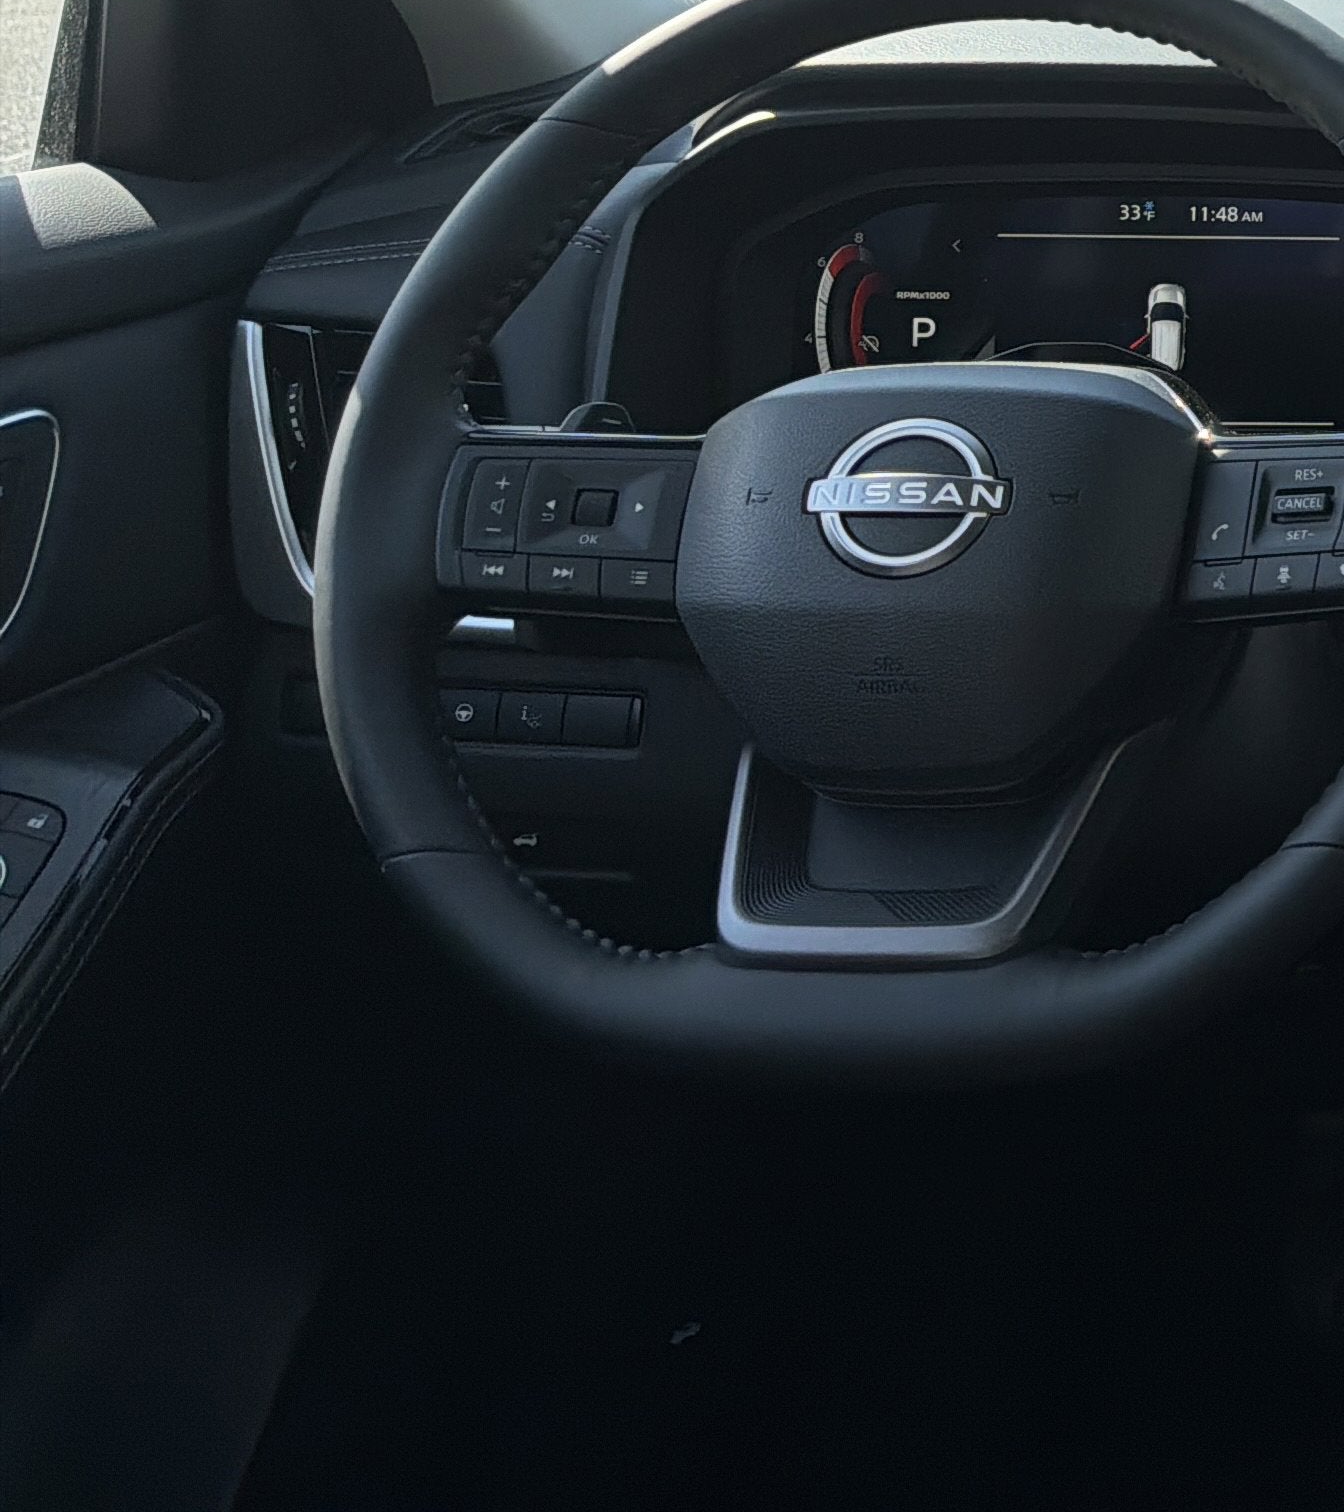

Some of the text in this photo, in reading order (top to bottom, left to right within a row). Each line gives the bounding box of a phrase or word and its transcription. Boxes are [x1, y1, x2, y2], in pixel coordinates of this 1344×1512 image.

[1190, 206, 1263, 222] 11:48 AM
[854, 233, 863, 243] 8
[818, 257, 825, 267] 6
[912, 318, 936, 347] P
[1295, 469, 1323, 481] RES+
[813, 482, 1004, 508] NISSAN
[1277, 497, 1322, 510] CANCEL
[579, 535, 598, 544] OK
